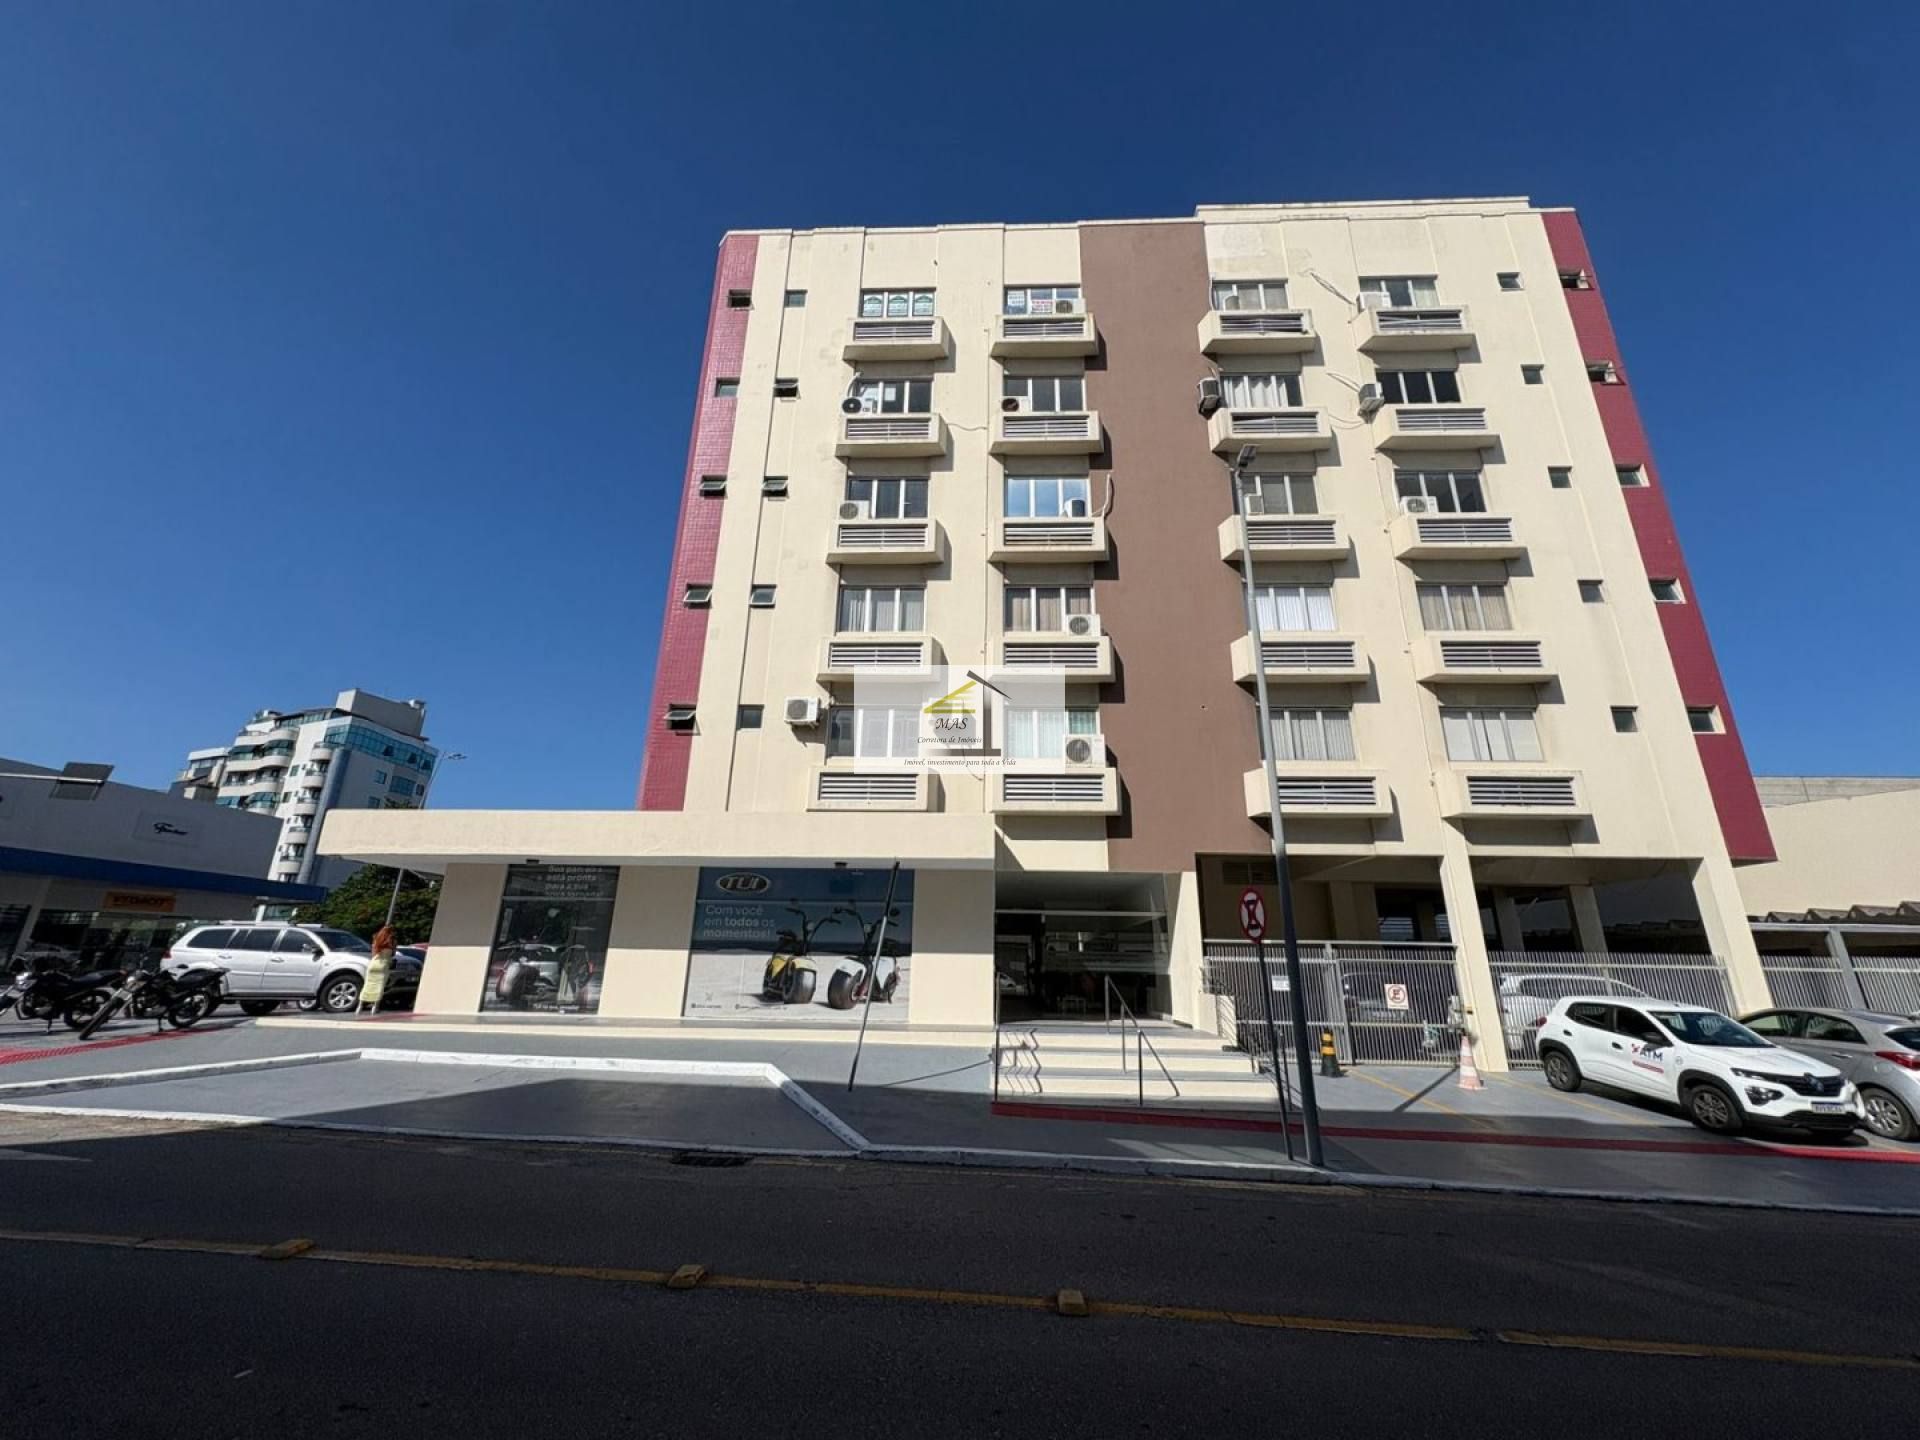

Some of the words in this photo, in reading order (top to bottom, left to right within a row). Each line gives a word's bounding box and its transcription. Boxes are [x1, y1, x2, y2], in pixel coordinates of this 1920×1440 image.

[705, 905, 733, 915] Com
[735, 904, 763, 915] você
[704, 919, 722, 927] em
[724, 916, 759, 927] todos
[761, 919, 776, 927] os
[703, 928, 770, 938] momentos!
